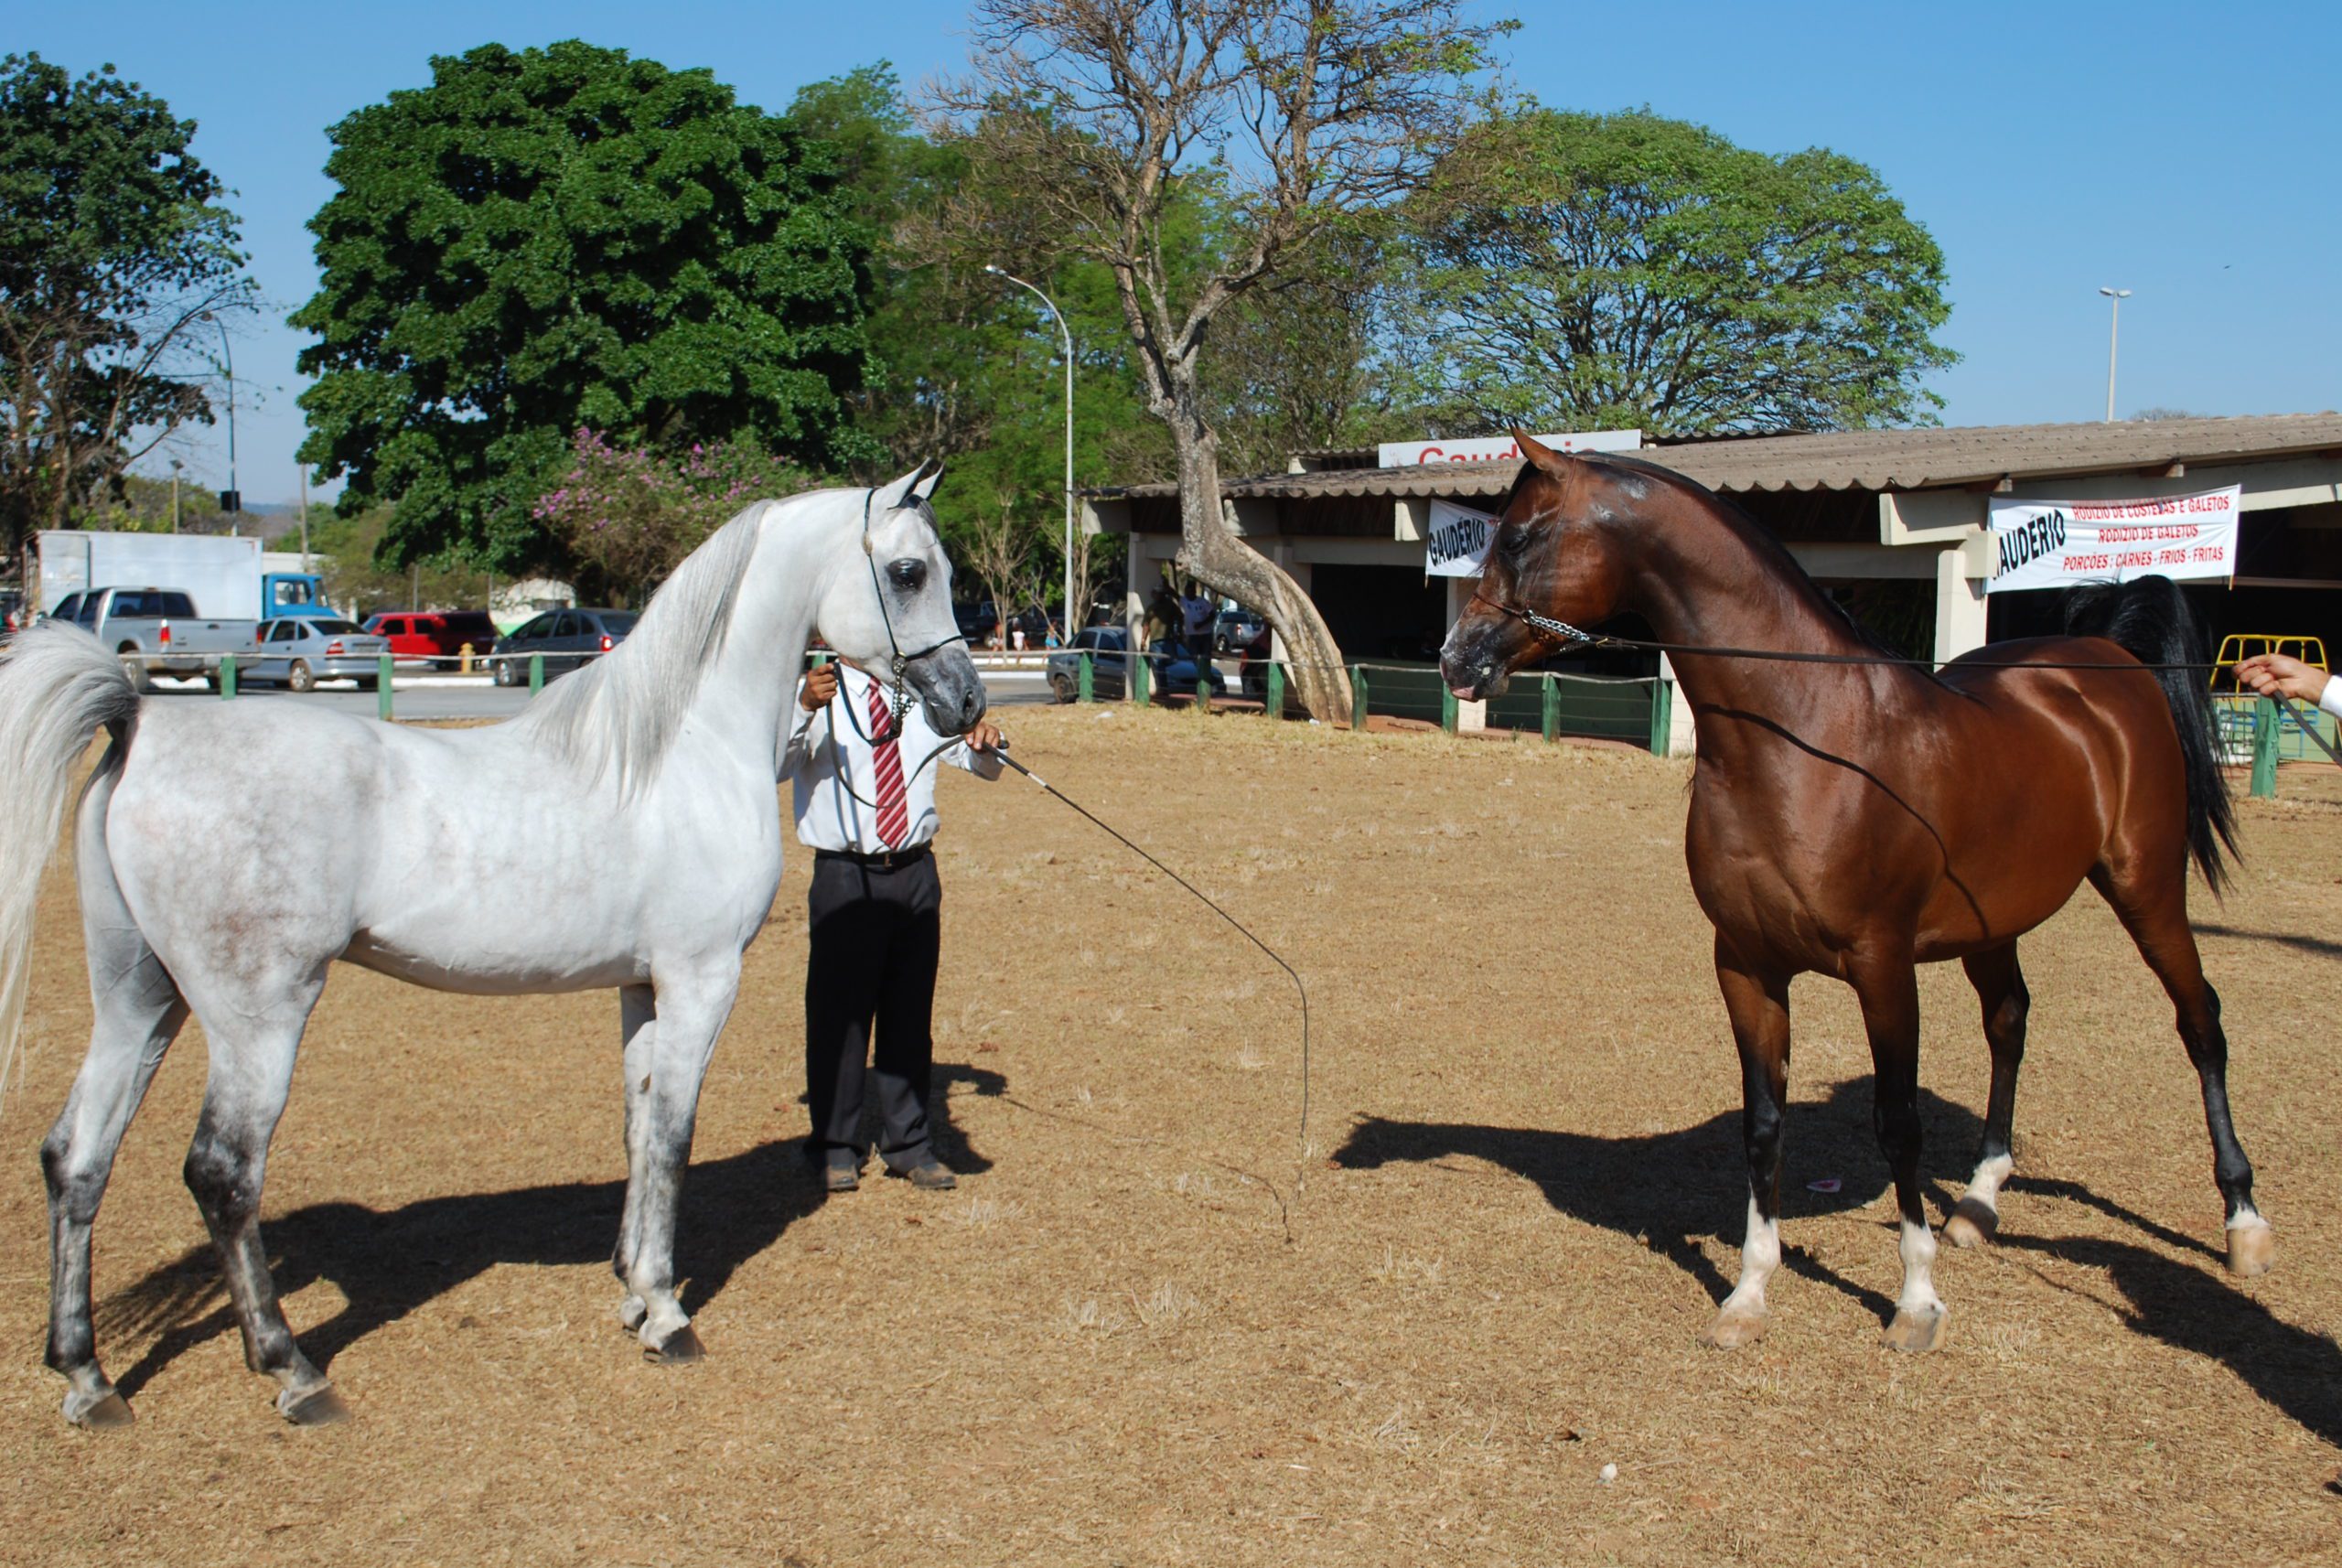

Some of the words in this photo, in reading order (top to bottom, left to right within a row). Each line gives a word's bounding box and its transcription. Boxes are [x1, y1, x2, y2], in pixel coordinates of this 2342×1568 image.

[2111, 504, 2124, 519] DE
[2178, 499, 2186, 513] E
[2188, 496, 2229, 512] GALETOS
[1428, 516, 1485, 566] GAUDÉRIO
[2142, 526, 2154, 540] DE
[2157, 523, 2199, 539] GALETOS
[1993, 509, 2066, 581] AUDÉRIO
[2115, 551, 2153, 568] CARNES
[2159, 549, 2186, 564] FRIOS
[2193, 546, 2224, 563] FRITAS
